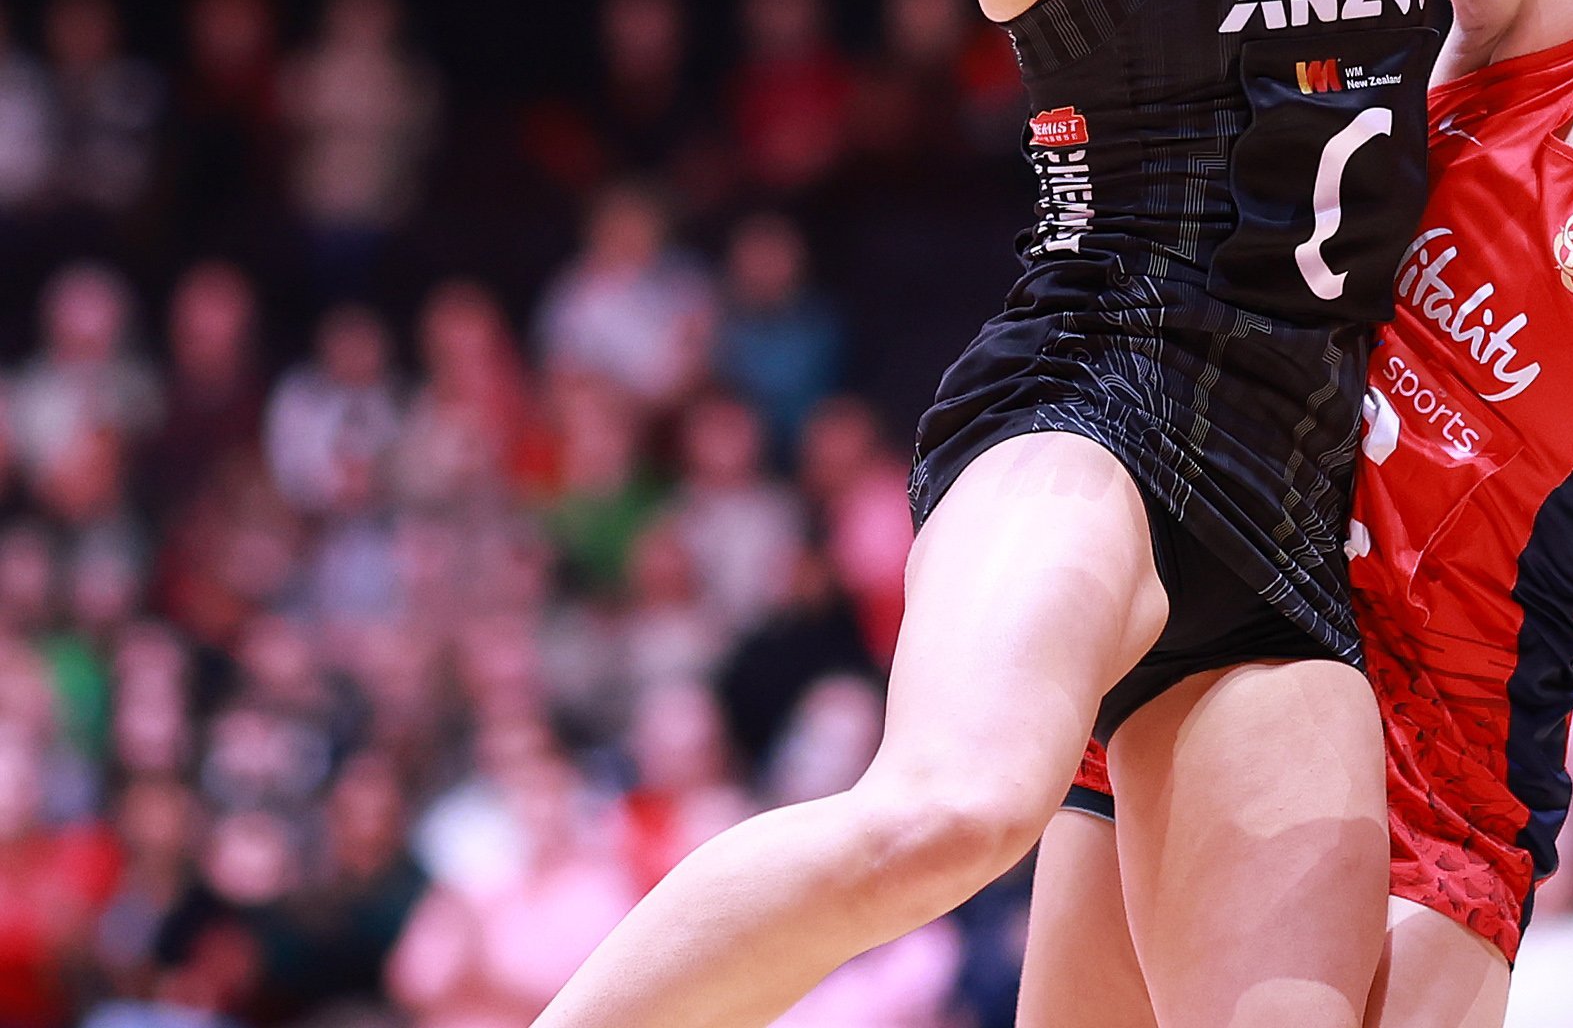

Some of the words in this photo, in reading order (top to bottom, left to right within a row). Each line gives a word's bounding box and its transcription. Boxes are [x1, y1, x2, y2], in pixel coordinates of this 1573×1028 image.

[1345, 66, 1363, 78] WM
[1346, 79, 1368, 90] New
[1368, 73, 1402, 87] Zealand
[1032, 119, 1079, 135] EMIST
[1382, 355, 1481, 455] sports
